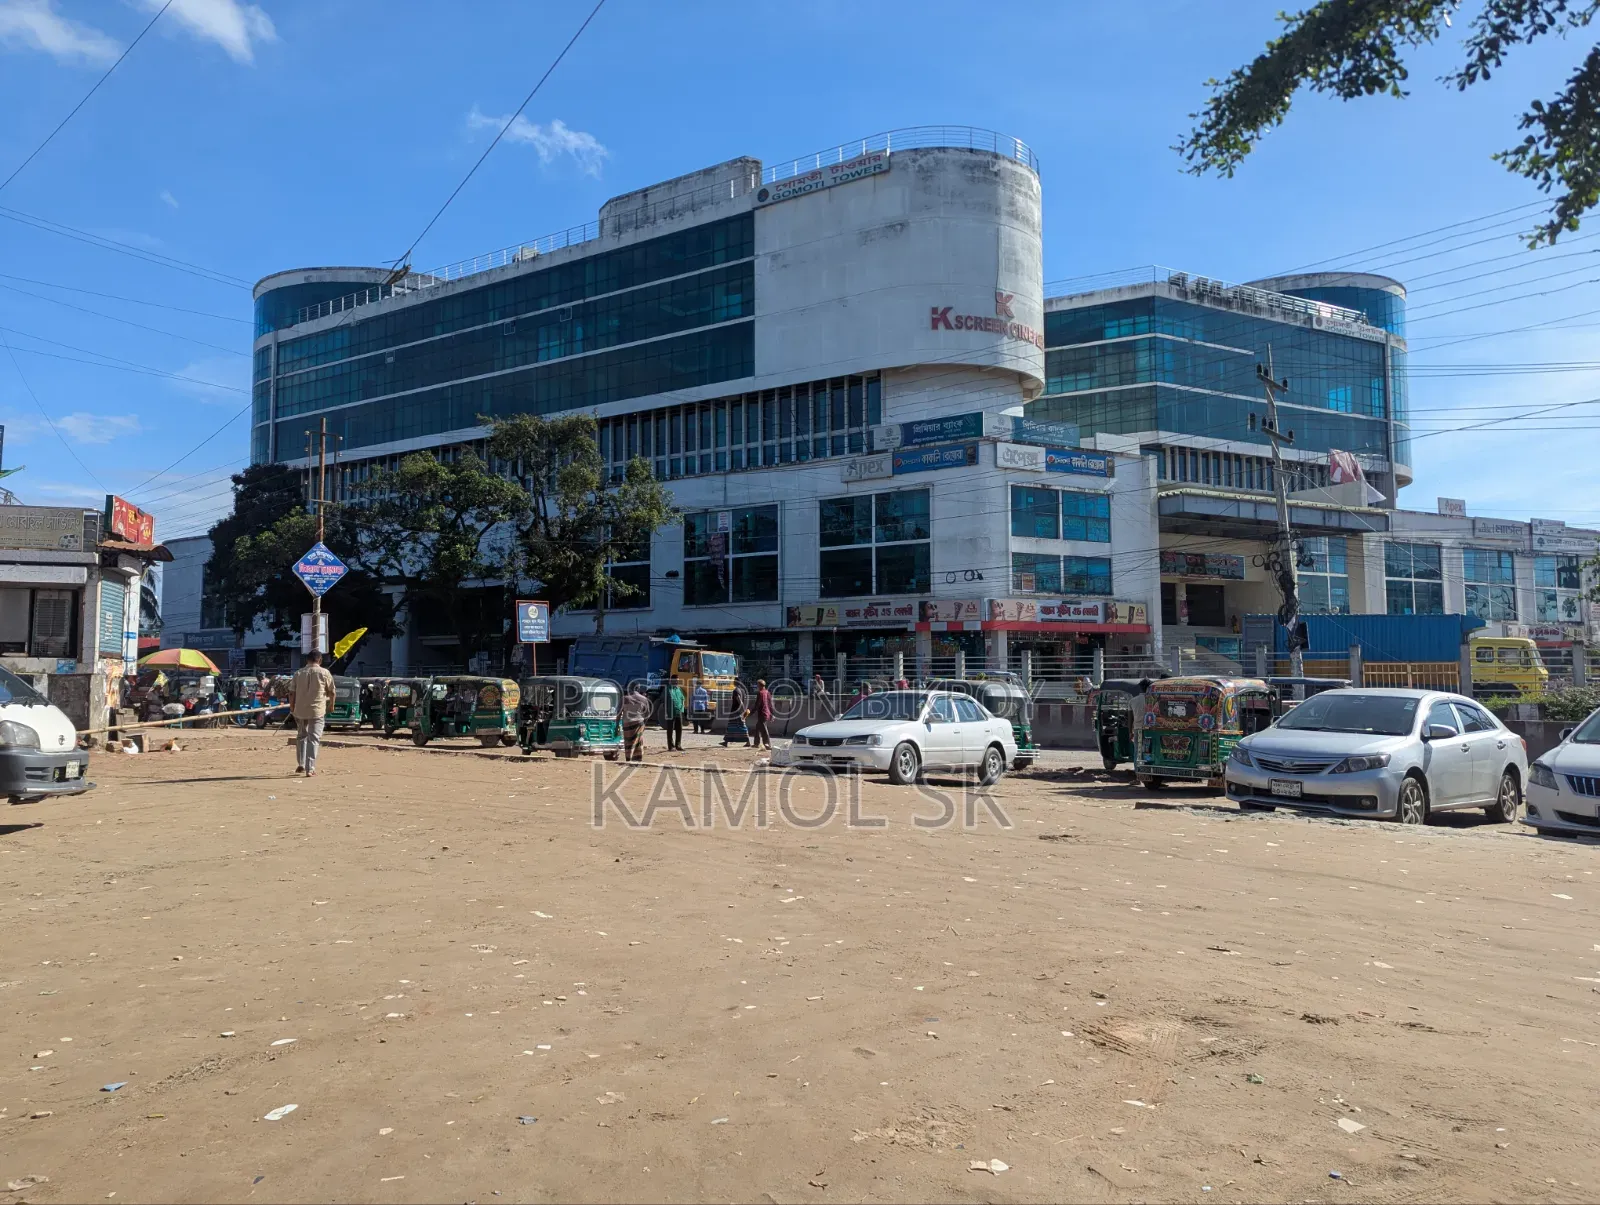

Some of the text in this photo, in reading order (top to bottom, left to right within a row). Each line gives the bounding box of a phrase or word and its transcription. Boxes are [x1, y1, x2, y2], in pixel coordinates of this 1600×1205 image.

[772, 163, 883, 201] GOMOTI TOWER
[1444, 500, 1463, 514] Apex
